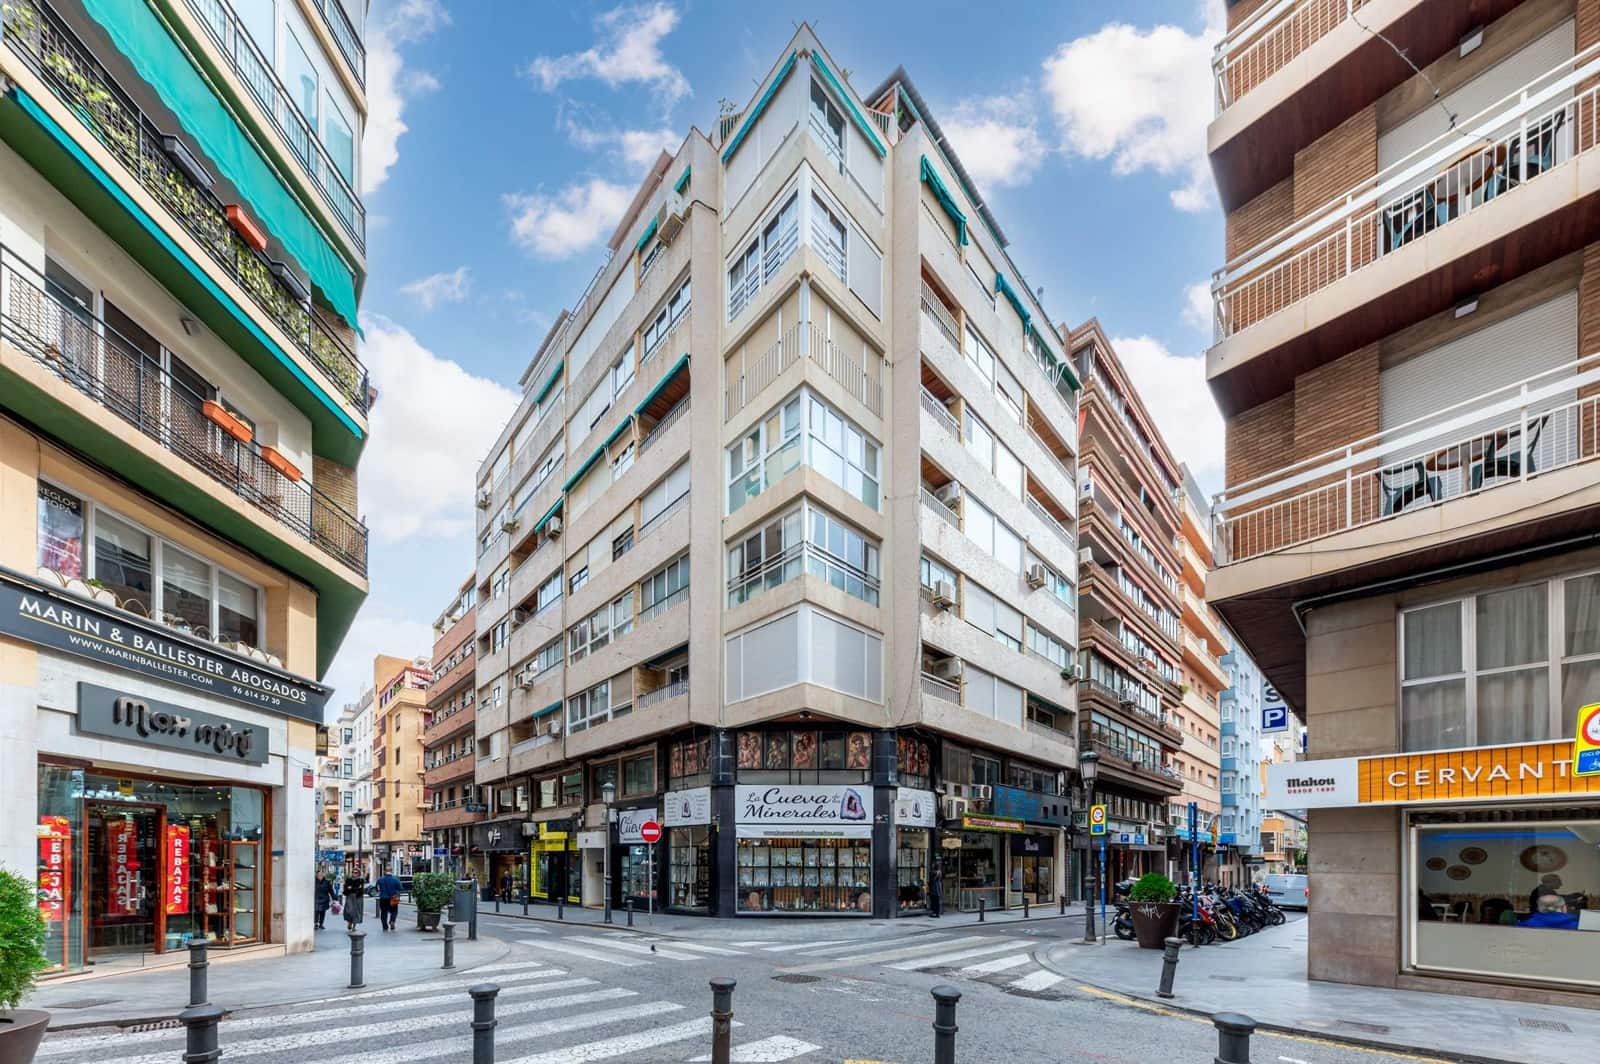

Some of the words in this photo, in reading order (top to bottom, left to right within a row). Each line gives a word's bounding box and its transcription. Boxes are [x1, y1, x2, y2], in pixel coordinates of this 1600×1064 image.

[20, 597, 100, 635] MARIN
[110, 628, 124, 643] &
[133, 635, 224, 675] BALLESTER
[231, 669, 307, 701] ABOGADOS
[69, 634, 213, 686] WWW.MARINBALLESTER.COM
[232, 685, 242, 695] 96
[244, 690, 258, 699] 614
[1264, 709, 1284, 728] P
[1287, 777, 1335, 788] Mahou
[1388, 760, 1573, 787] CERVANT
[746, 792, 760, 803] La
[763, 787, 830, 804] Cueva
[743, 804, 837, 819] Minerales
[173, 838, 183, 904] REBAJAS
